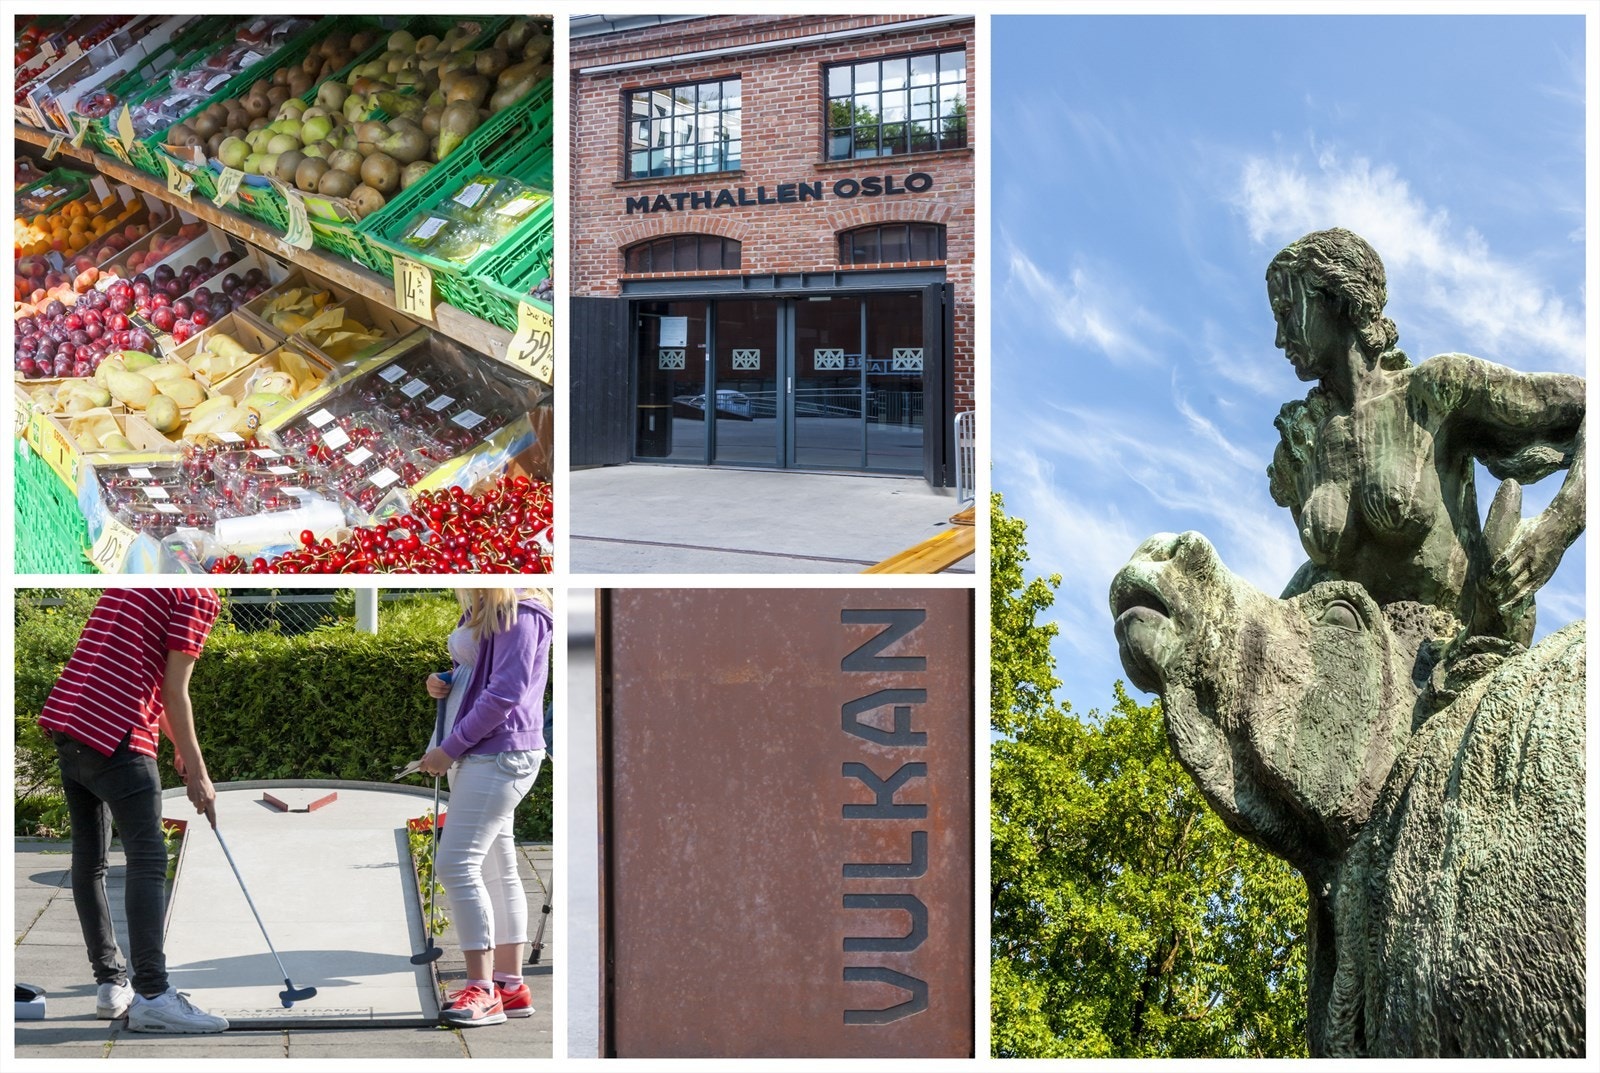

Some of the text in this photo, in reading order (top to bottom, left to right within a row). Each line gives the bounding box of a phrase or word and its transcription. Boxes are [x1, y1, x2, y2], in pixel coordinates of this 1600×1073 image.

[626, 172, 933, 215] MATHALLEN OSLO
[402, 270, 416, 311] 14
[518, 328, 551, 367] 59
[841, 608, 928, 1026] VULKAN
